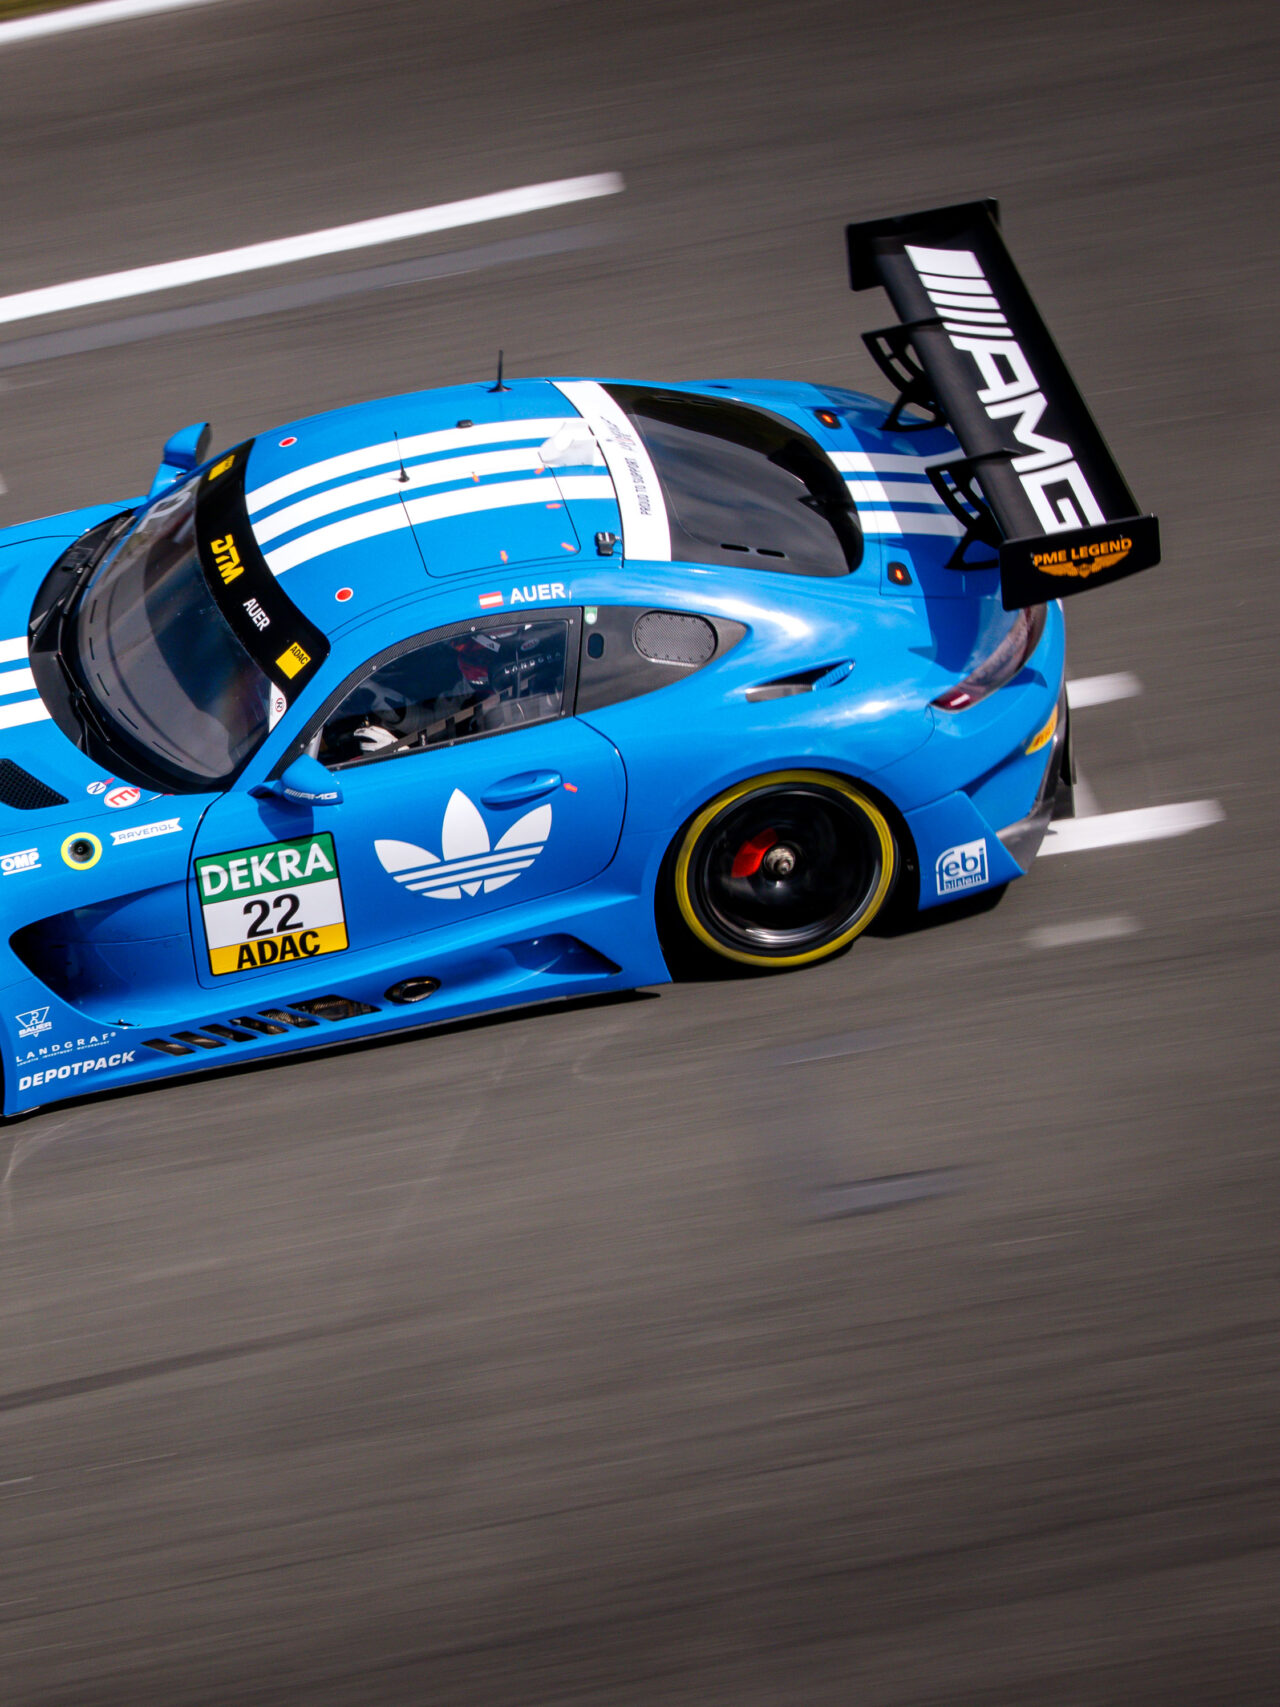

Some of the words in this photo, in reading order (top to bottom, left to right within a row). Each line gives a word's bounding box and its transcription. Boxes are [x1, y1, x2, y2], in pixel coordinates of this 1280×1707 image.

[949, 334, 1107, 535] AMG
[210, 533, 244, 586] DTM
[1033, 549, 1067, 567] PME
[1071, 538, 1132, 560] LEGEND
[510, 583, 566, 604] AUER
[242, 598, 271, 631] AUER
[289, 645, 308, 665] ADAC
[118, 823, 175, 841] RAVENOL
[1, 851, 40, 871] OMP
[200, 842, 334, 897] DEKRA
[937, 847, 986, 892] febi
[243, 893, 304, 939] 22
[237, 931, 320, 970] ADAC
[19, 1021, 52, 1036] BAUER
[19, 1050, 136, 1091] DEPOTPACK
